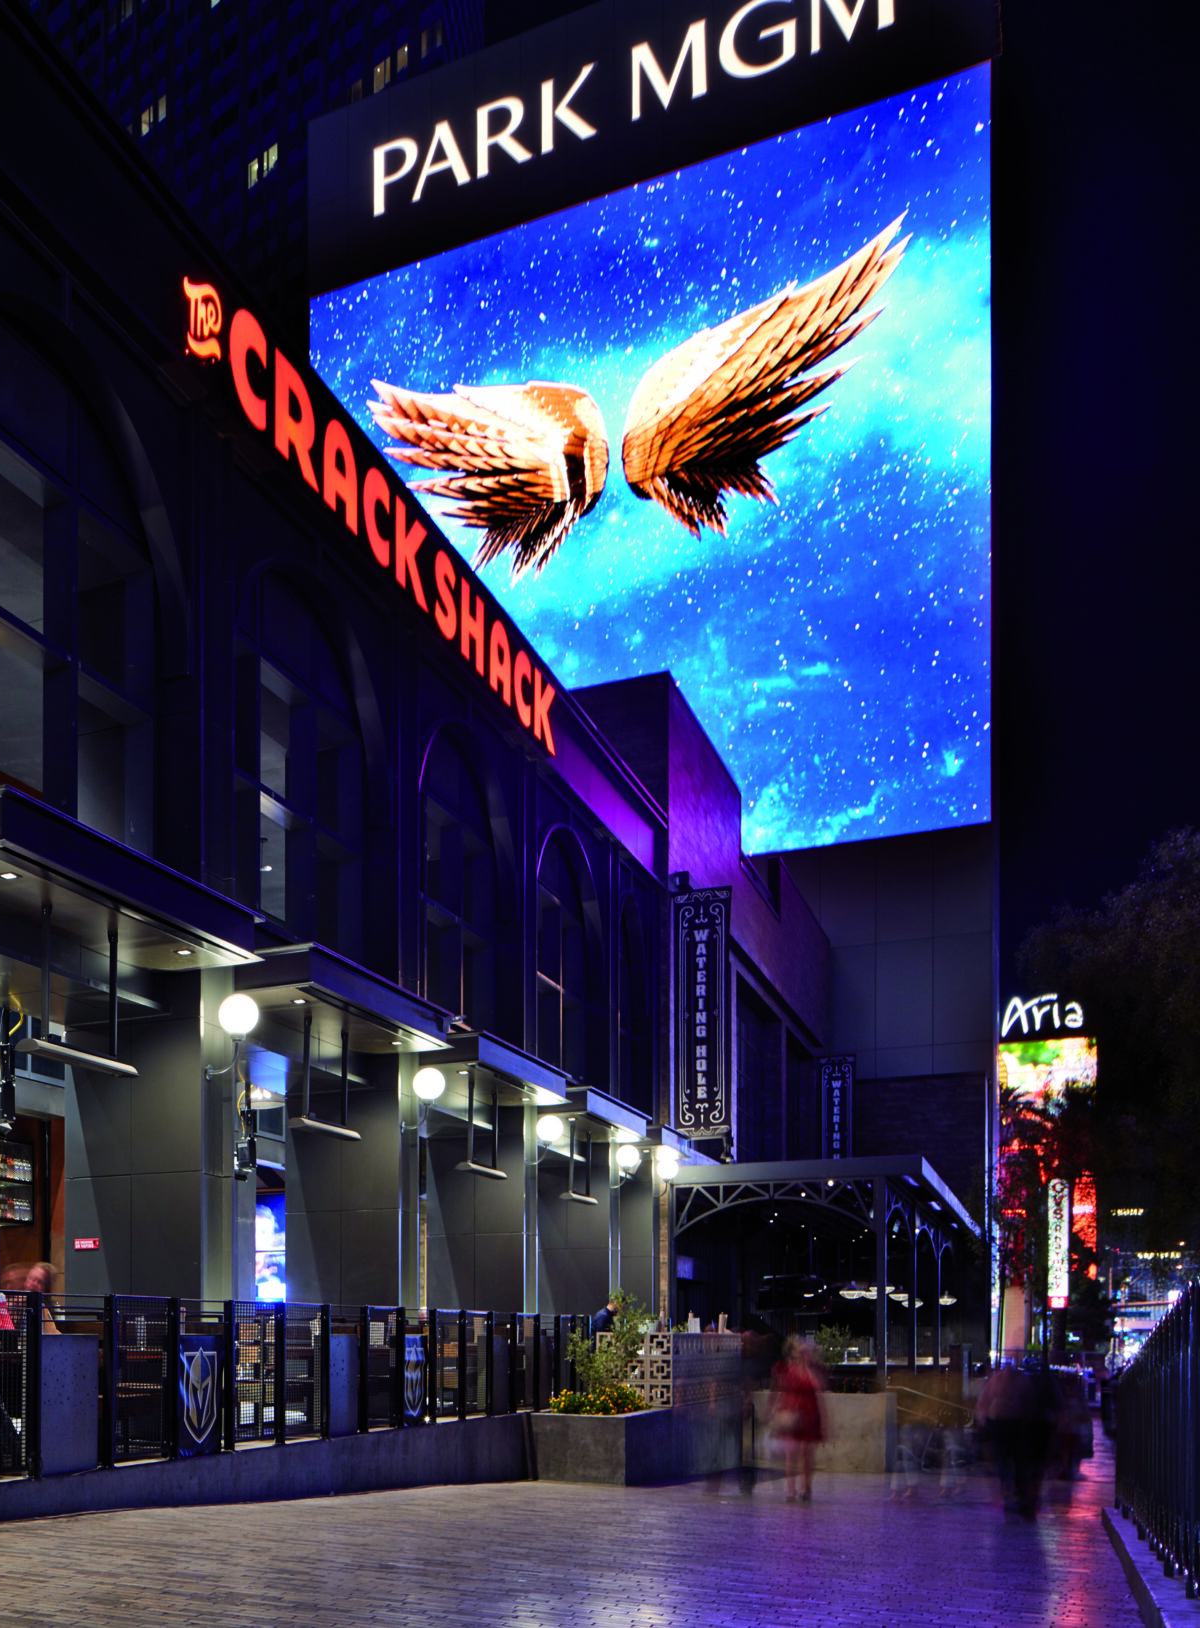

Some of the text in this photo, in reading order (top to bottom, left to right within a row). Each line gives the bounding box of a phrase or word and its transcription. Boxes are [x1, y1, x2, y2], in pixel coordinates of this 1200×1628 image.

[374, 0, 895, 216] PARK MGM
[183, 276, 556, 757] The CRACK SHACK
[694, 930, 710, 1100] WATERING HOLE
[832, 1080, 842, 1149] WATERING
[1052, 1182, 1065, 1220] CVS
